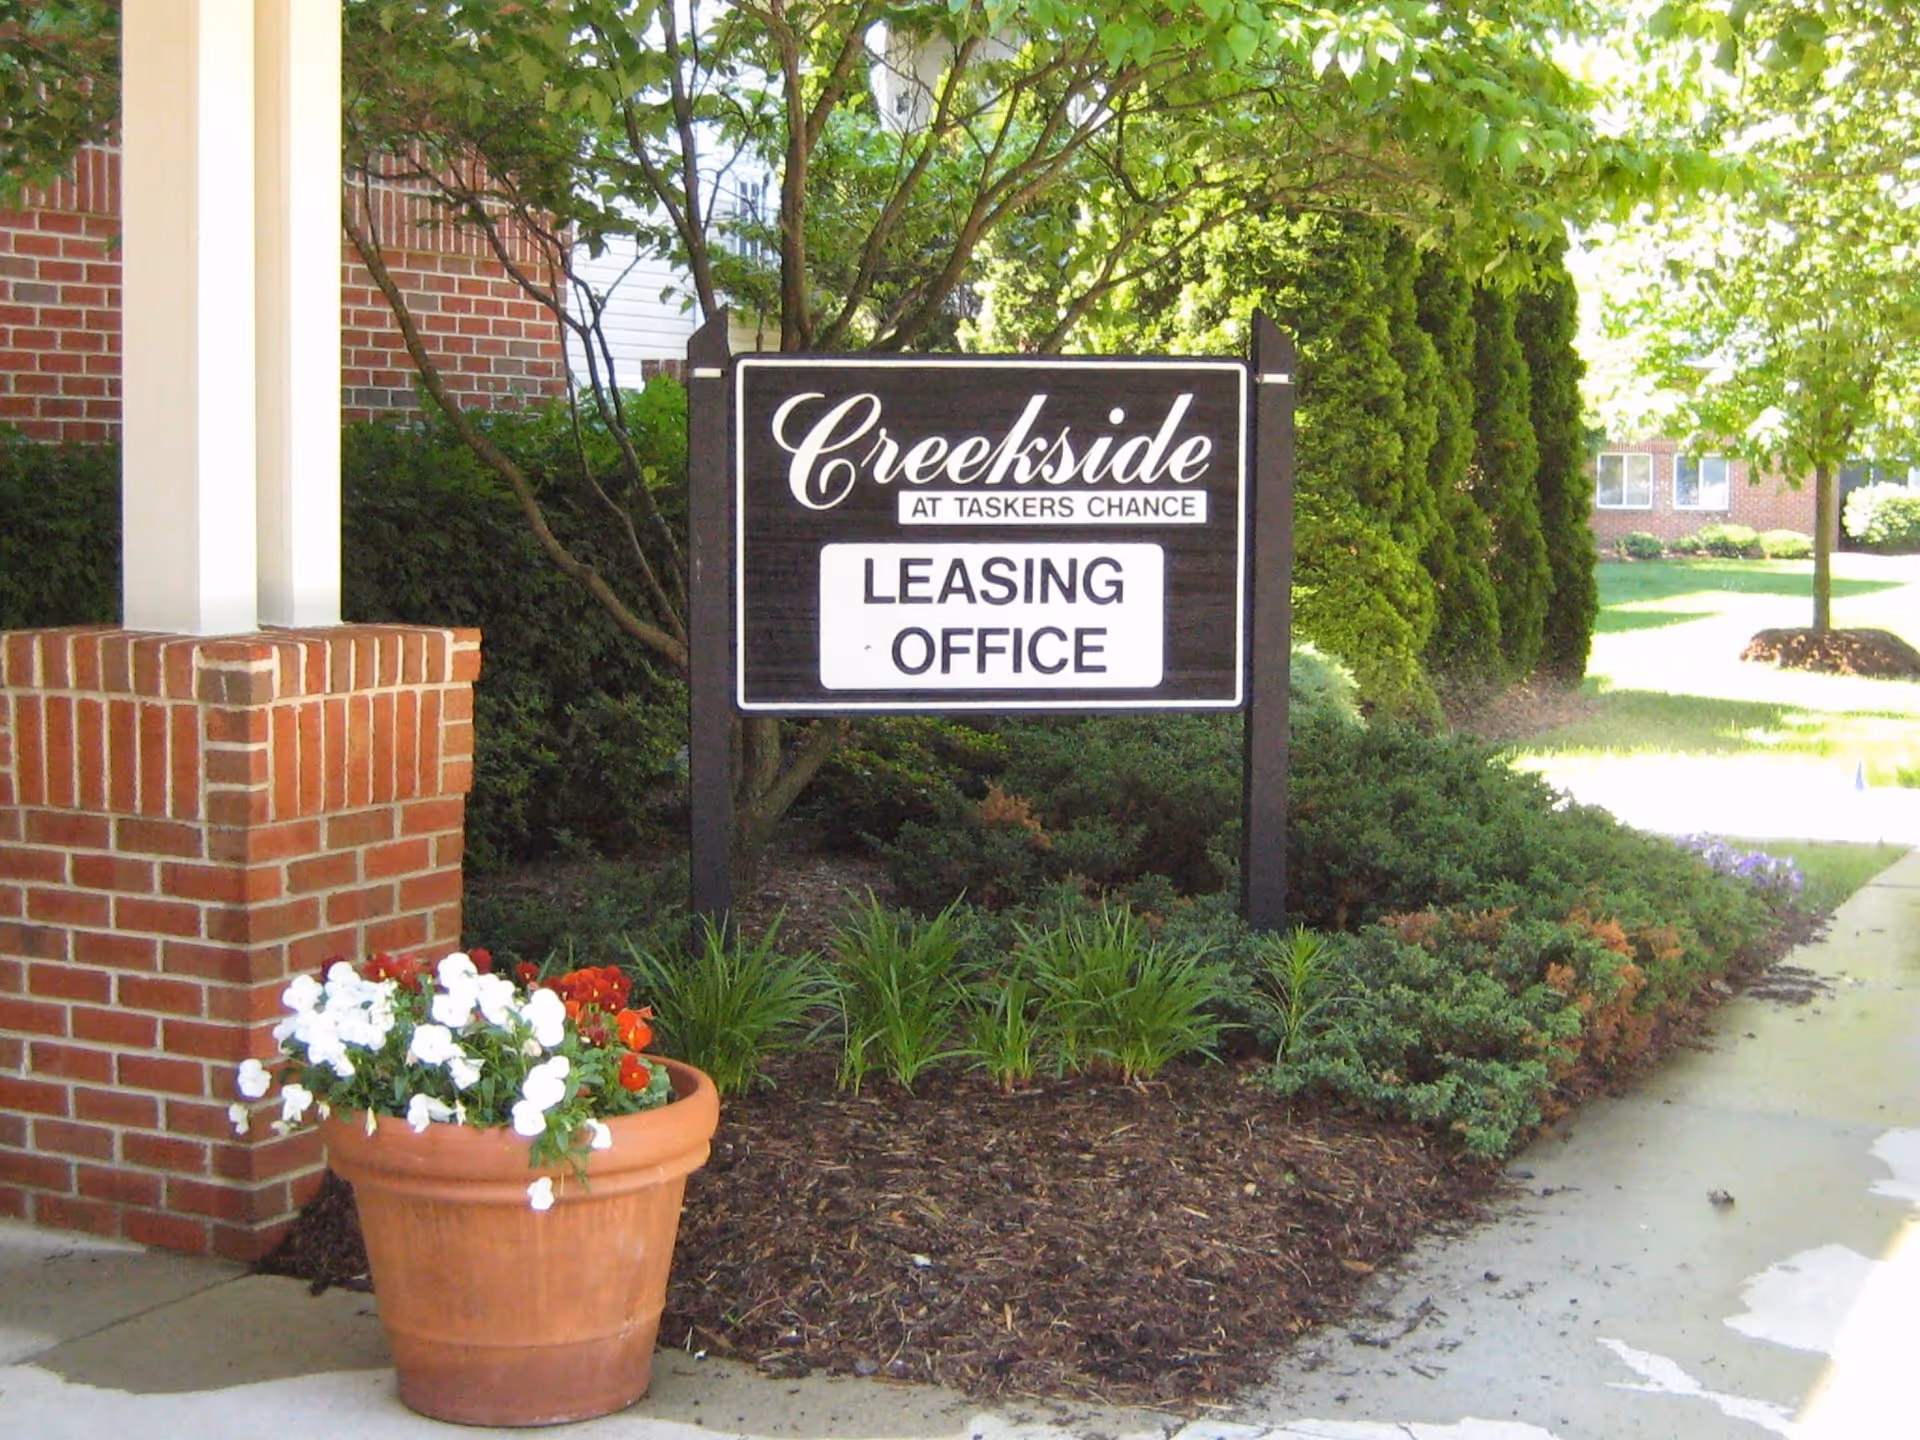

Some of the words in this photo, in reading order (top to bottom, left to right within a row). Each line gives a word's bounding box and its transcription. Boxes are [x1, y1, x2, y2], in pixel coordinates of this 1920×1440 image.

[771, 392, 1212, 510] Creekside
[911, 497, 941, 517] AT
[955, 496, 1074, 518] TASKERS
[1087, 496, 1196, 517] CHANCE
[863, 556, 1124, 605] LEASING
[891, 626, 1107, 675] OFFICE
